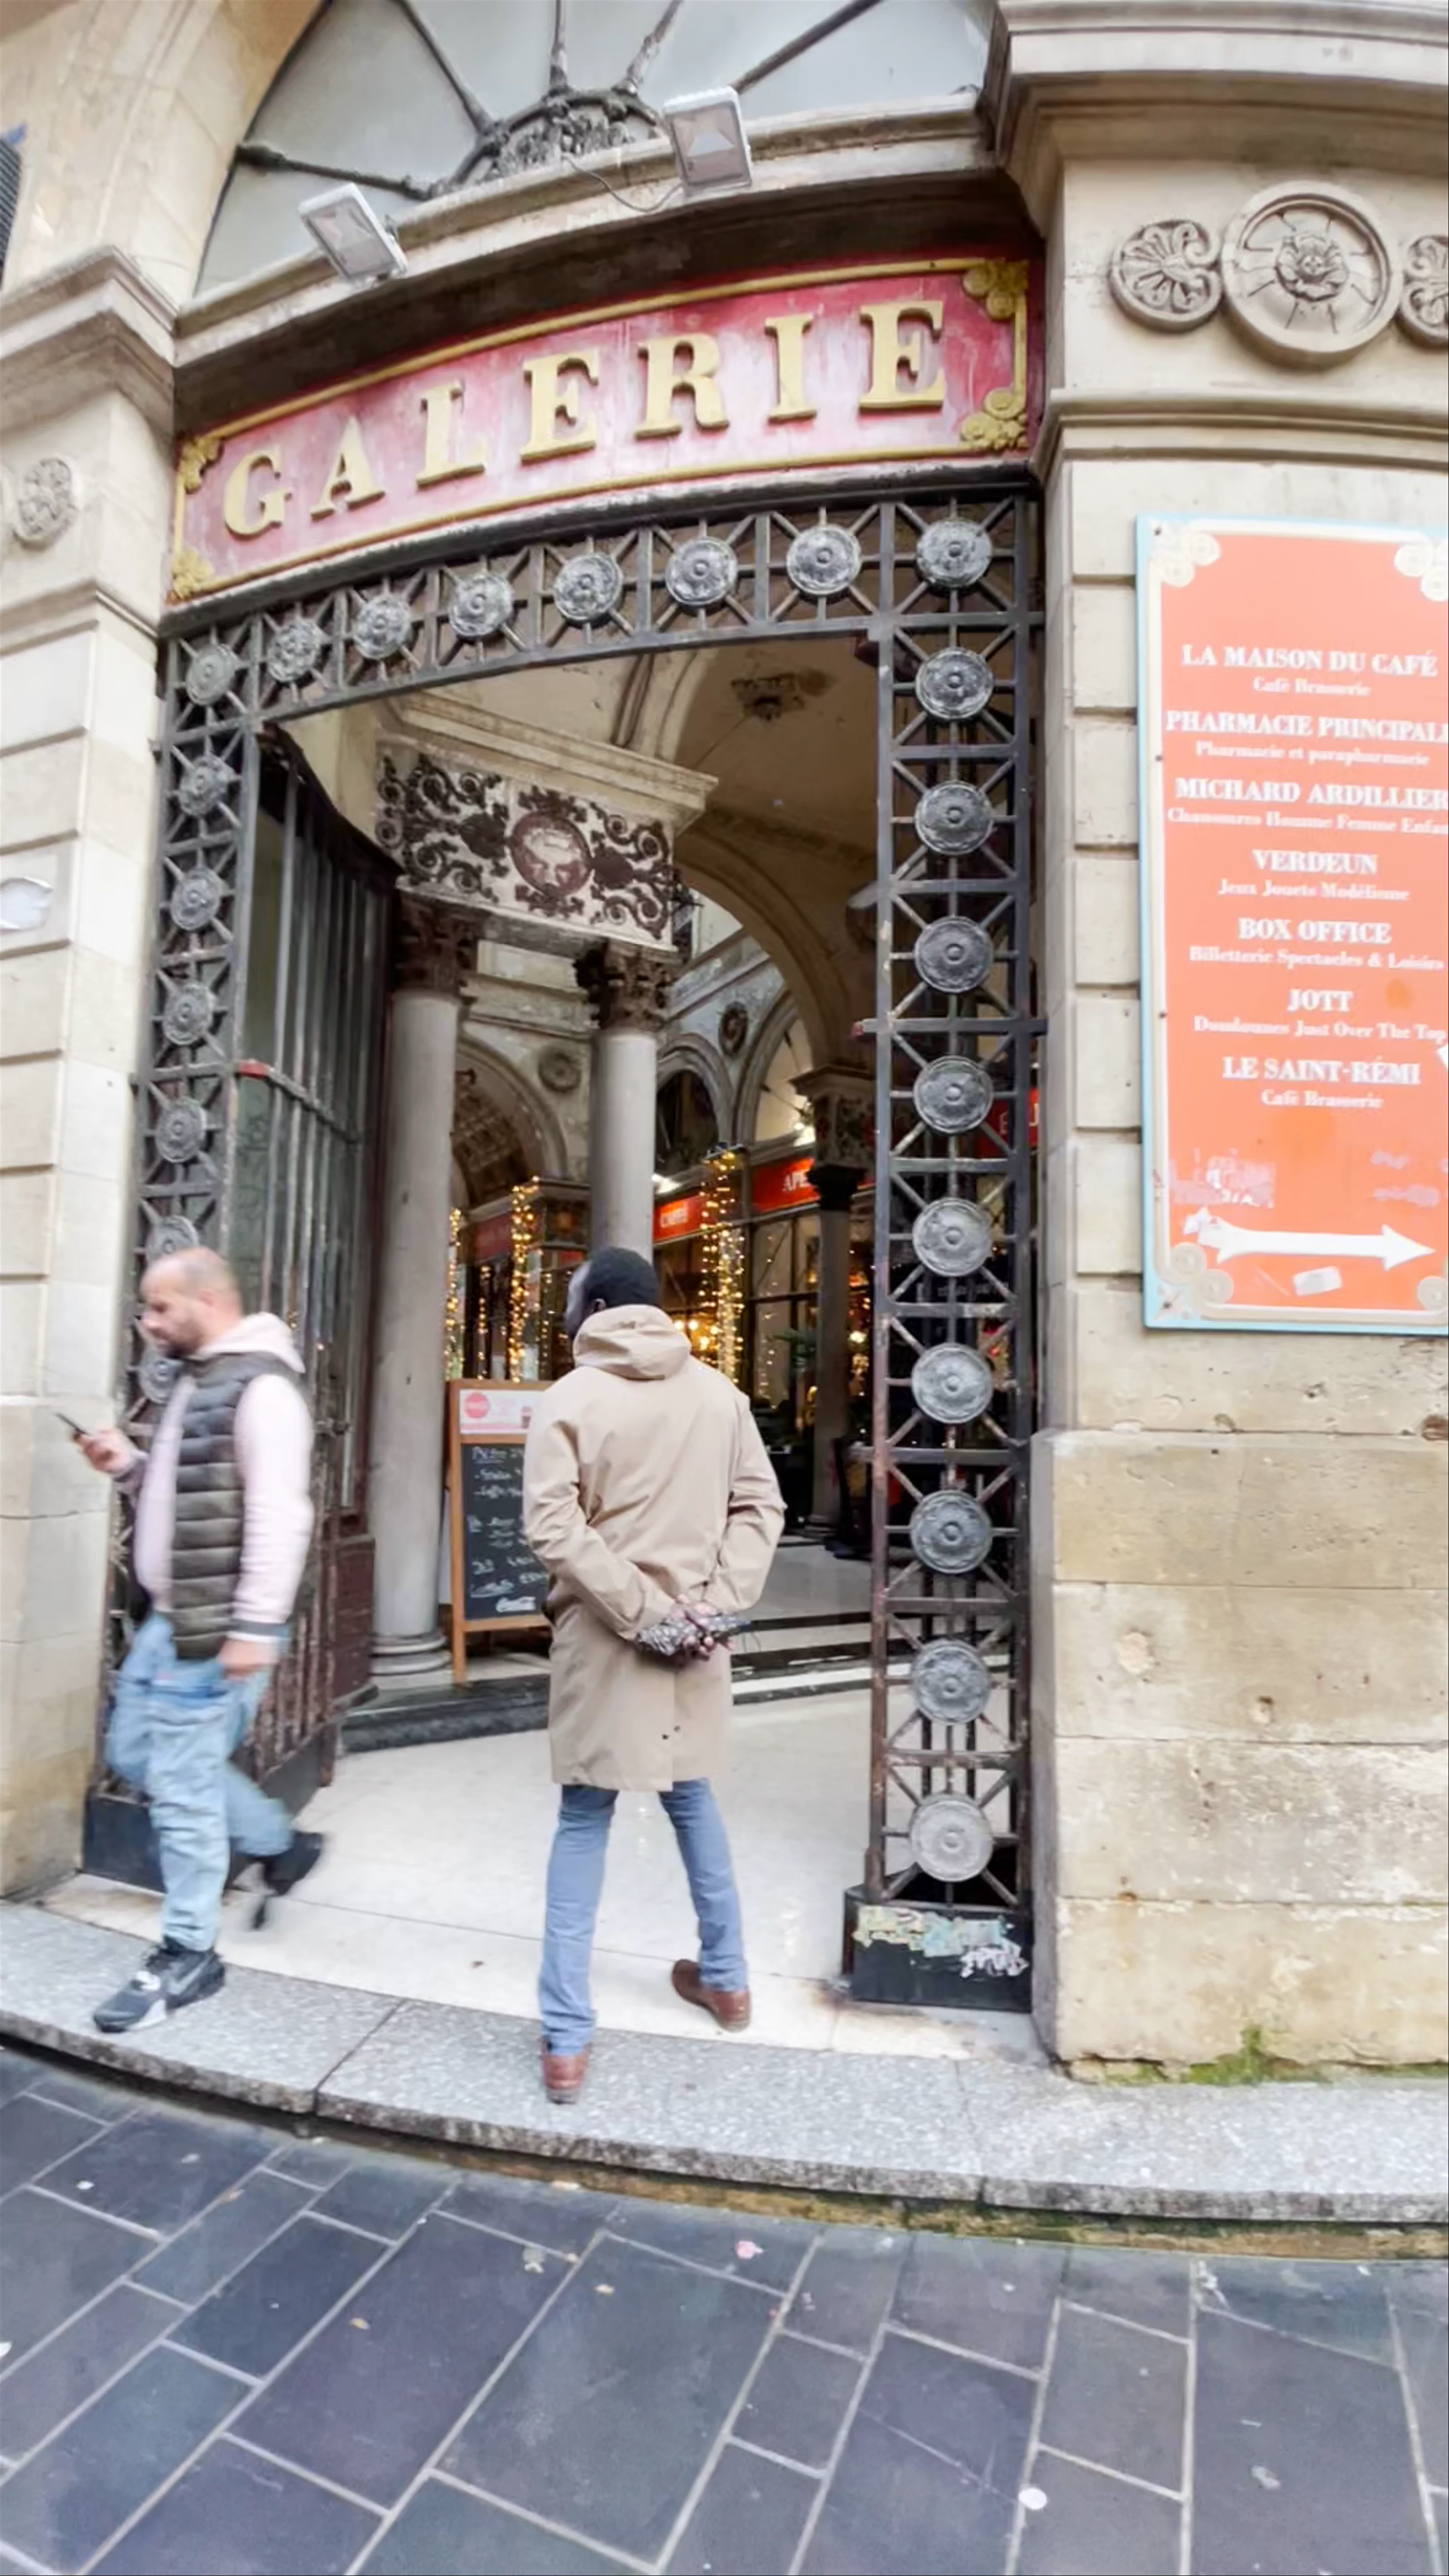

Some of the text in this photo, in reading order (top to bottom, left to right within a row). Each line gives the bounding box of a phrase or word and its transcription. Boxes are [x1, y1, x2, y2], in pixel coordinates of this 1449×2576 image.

[223, 301, 944, 540] GALERIE
[1182, 644, 1438, 677] LA MAISON DU CAFÉ
[1295, 678, 1371, 696] Brasserie
[1166, 710, 1313, 736] PHARMACIE
[1195, 740, 1429, 766] Pharmacie et parapharmacie
[1174, 777, 1301, 802] MICHARD
[1266, 811, 1333, 828] Homme
[1337, 814, 1397, 832] Femme
[1252, 849, 1379, 874] VERDEUN
[1218, 878, 1411, 901] Jeux Jouets Modélisme
[1238, 917, 1393, 944] BOX OFFICE
[1189, 946, 1445, 970] Billetterie Spectacles & Loisirs
[1287, 988, 1354, 1012] JOTT
[1194, 1015, 1447, 1044] Doudounes Just Over The Top
[1222, 1055, 1421, 1085] LE SAINT-RÉMI
[1303, 1090, 1384, 1109] Brasserie
